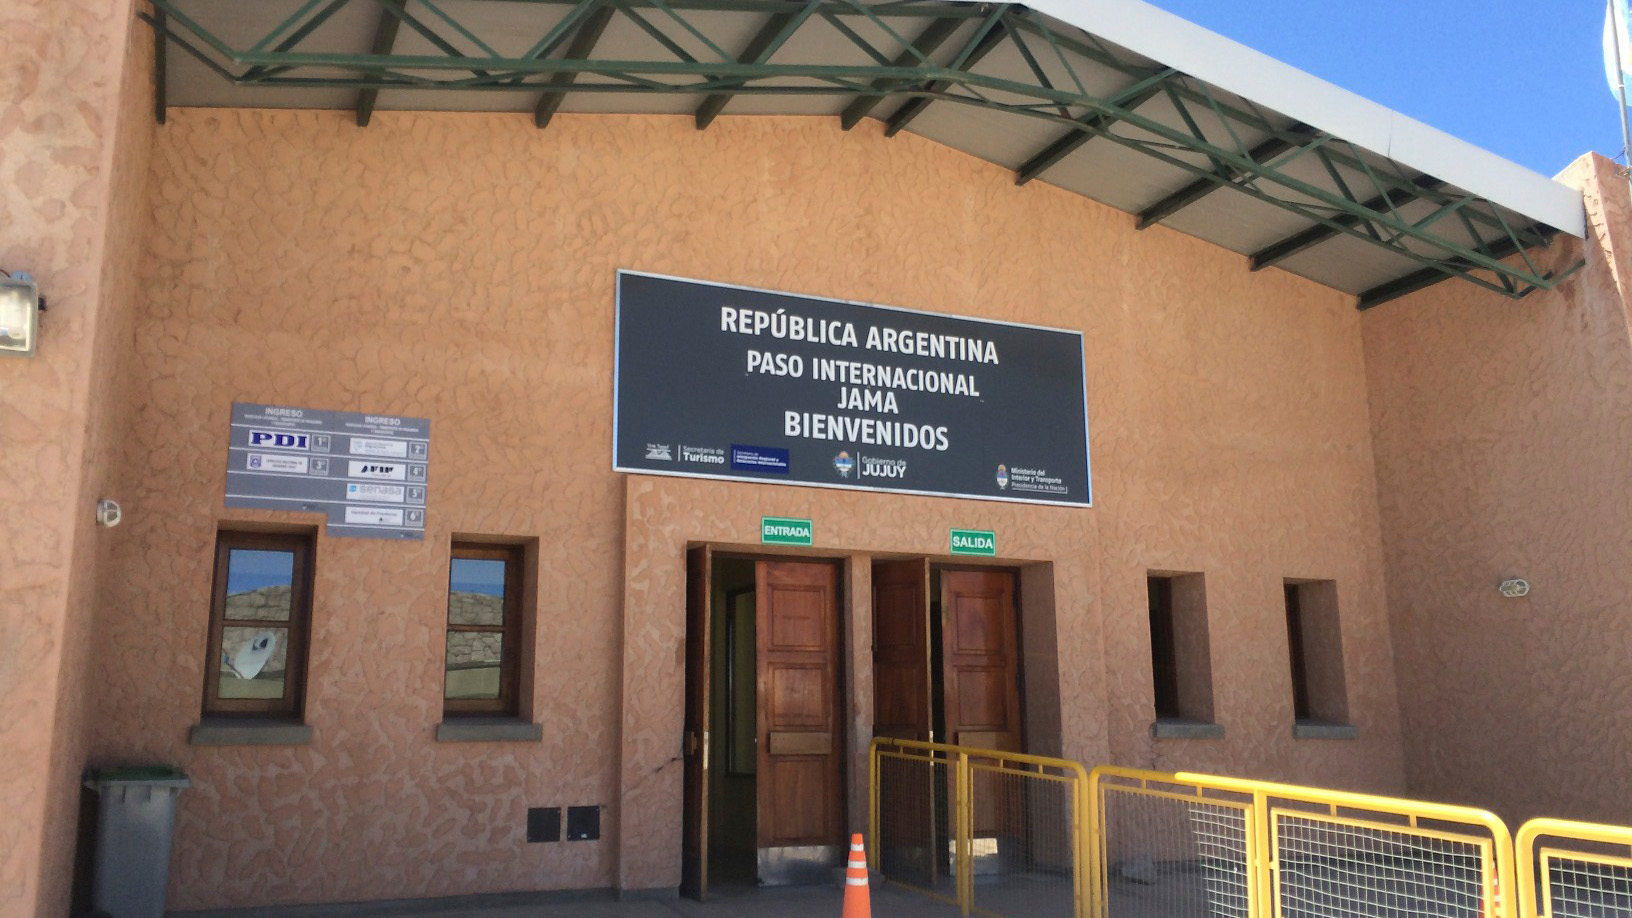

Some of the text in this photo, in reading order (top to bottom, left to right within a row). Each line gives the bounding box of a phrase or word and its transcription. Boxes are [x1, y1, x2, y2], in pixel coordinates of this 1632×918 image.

[720, 306, 999, 365] REPÚBLICA ARGENTINA
[746, 349, 980, 397] PASO INTERNACIONAL
[837, 387, 898, 415] JAMA
[265, 407, 303, 418] INGRESO
[364, 416, 401, 426] INGRESO
[784, 410, 949, 451] BIENVENIDOS
[251, 432, 307, 448] PDI
[683, 451, 725, 464] Turismo
[862, 456, 895, 465] Gobierno
[862, 463, 907, 478] JUJUY
[359, 485, 402, 496] senasa
[764, 525, 810, 538] ENTRADA
[953, 535, 993, 549] SALIDA
